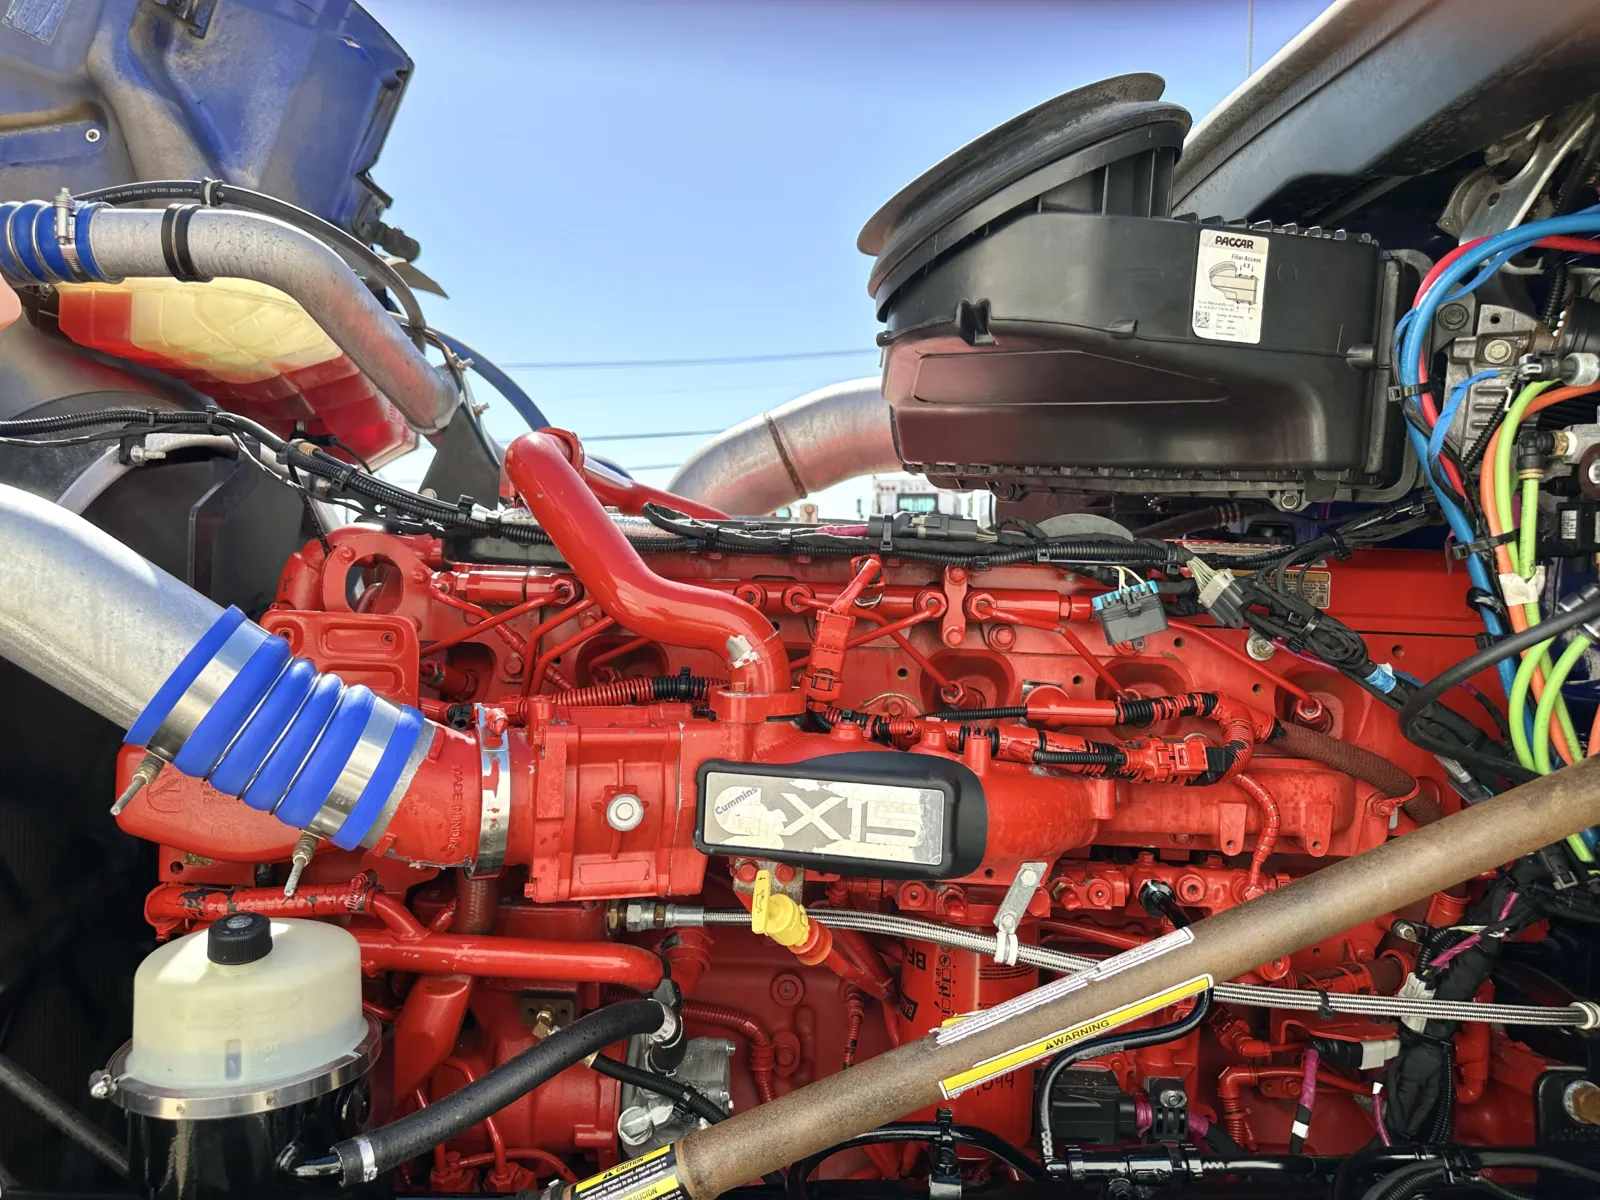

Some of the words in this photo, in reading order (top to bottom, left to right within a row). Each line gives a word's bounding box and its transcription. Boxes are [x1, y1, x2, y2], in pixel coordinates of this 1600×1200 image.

[1215, 236, 1254, 249] PACCAR
[451, 765, 462, 800] MADE
[451, 804, 462, 815] IN
[714, 786, 758, 816] Cummins
[447, 818, 461, 849] INDIA
[780, 792, 927, 848] X15
[1052, 1020, 1110, 1046] WARNING
[616, 1156, 644, 1172] CAUTION
